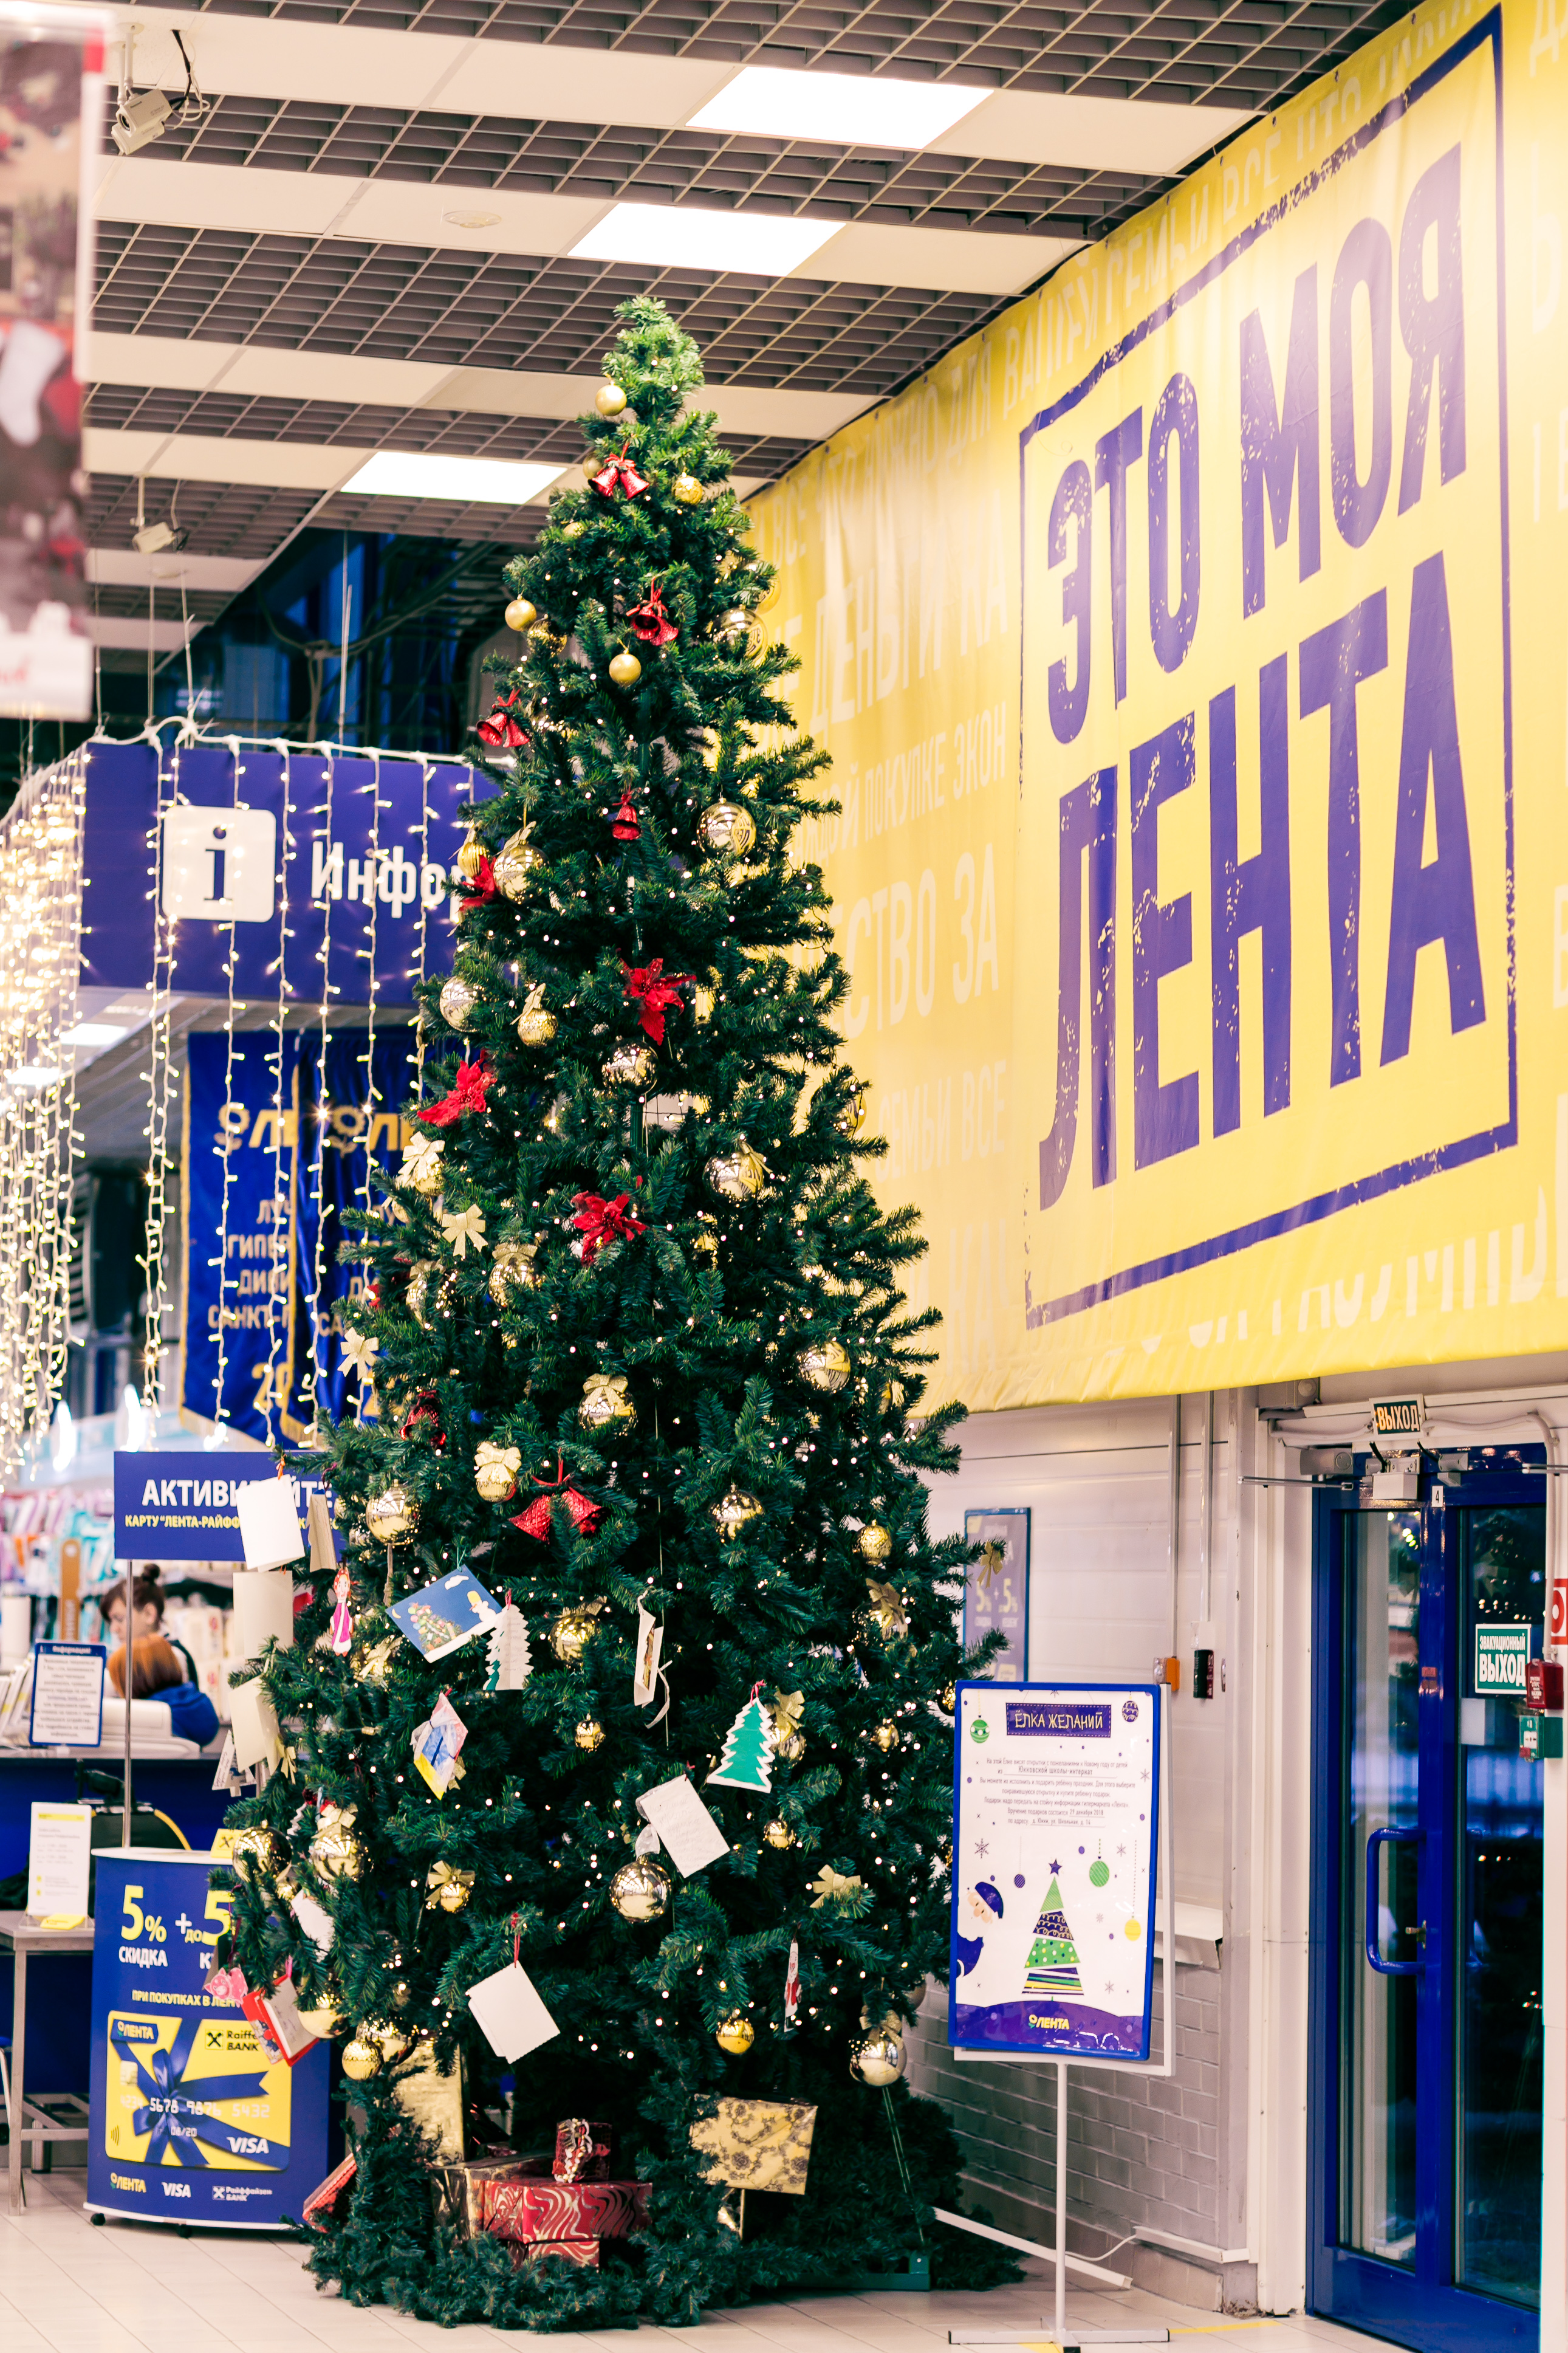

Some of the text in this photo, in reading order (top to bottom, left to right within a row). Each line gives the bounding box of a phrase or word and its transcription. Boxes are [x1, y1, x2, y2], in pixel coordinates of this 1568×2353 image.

[1047, 373, 1200, 743] ЭТО
[1239, 142, 1467, 619] МОЯ
[865, 731, 947, 843] ПОКУПКЕ
[953, 700, 1007, 800] ЭКОН
[1039, 550, 1486, 1211] ЛЕНТА
[953, 842, 999, 1004] ЗА
[962, 1059, 1007, 1163] ВСЕ
[1376, 1405, 1420, 1432] ВЫХОД
[1436, 1490, 1440, 1503] 4
[125, 1515, 159, 1528] КАРТУ
[1479, 1633, 1525, 1653] ЭВАКУАЦИОННЫЙ
[1479, 1653, 1526, 1687] ВЫХОД
[1015, 1709, 1103, 1731] ЁЛКА ЖЕЛАНИЙ
[118, 1946, 168, 1969] СКИДКА
[132, 1990, 148, 2002] ПРИ
[149, 1991, 201, 2006] ПОКУПКАХ
[202, 1996, 211, 2007] В
[123, 2023, 154, 2040] ЛЕНТА
[1036, 2016, 1070, 2030] ЛЕНТА
[227, 2042, 259, 2052] BANK
[149, 2097, 179, 2114] 5678
[186, 2100, 222, 2116] 9876
[231, 2103, 270, 2118] 5432
[226, 2136, 269, 2154] VISA
[117, 2176, 146, 2193] ЛЕНТА
[162, 2182, 191, 2198] VISA
